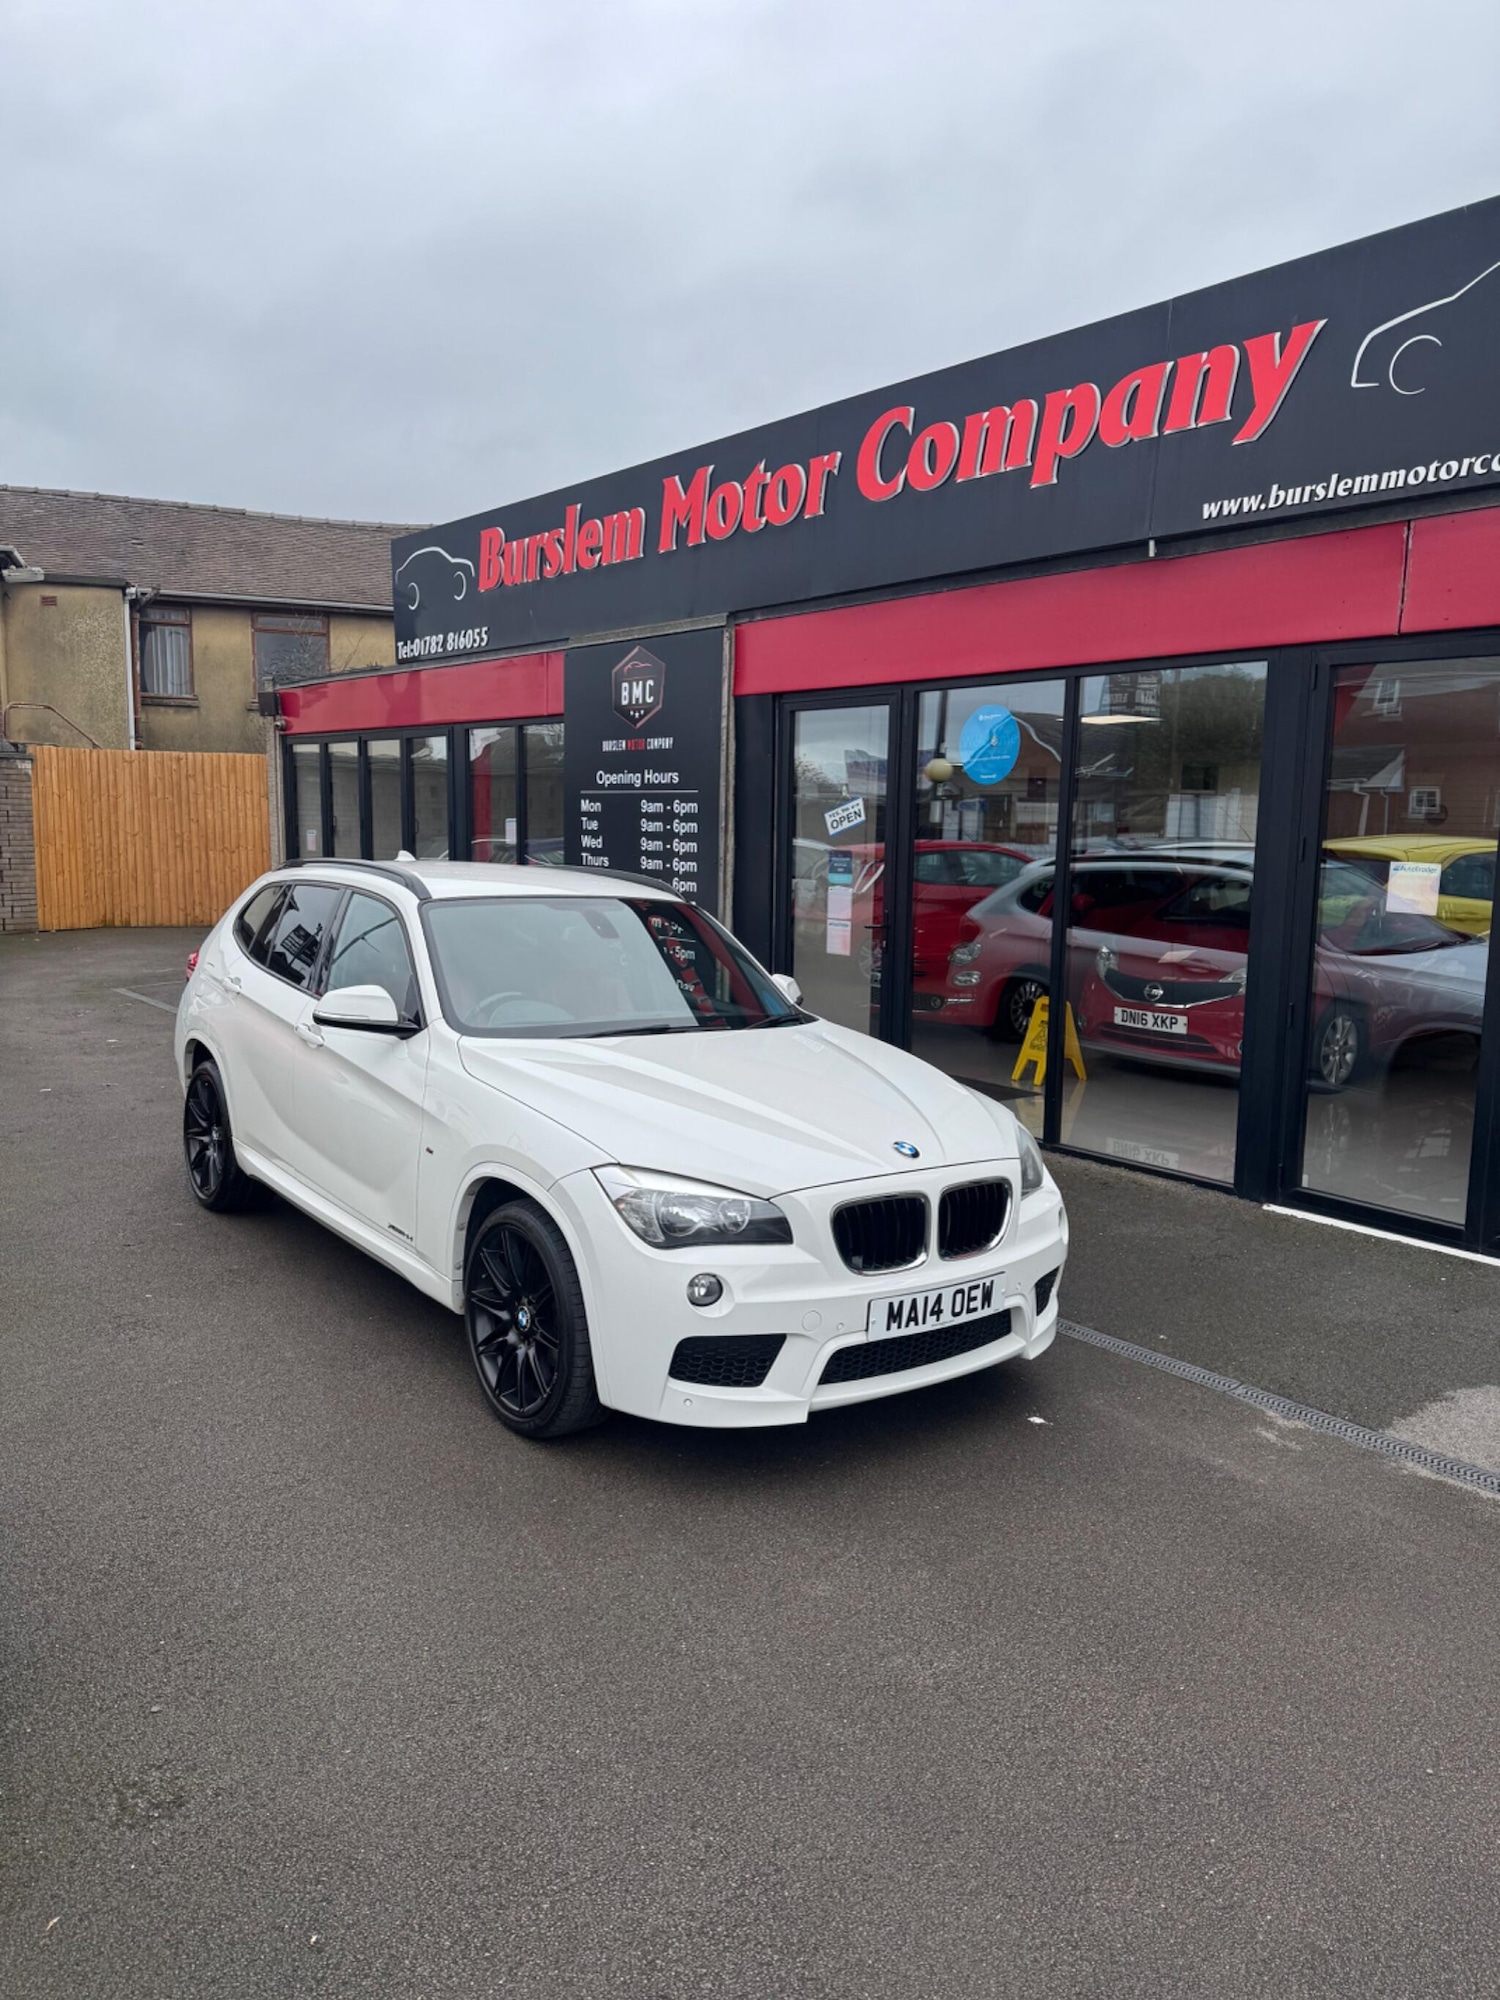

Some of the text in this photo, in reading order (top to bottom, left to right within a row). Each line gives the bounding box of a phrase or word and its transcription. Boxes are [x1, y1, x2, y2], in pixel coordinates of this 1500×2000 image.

[478, 318, 1329, 593] Burslem Motor Company
[397, 626, 489, 660] Tel:01782 816055
[621, 679, 655, 706] BMC
[596, 769, 679, 787] Opening Hours
[580, 799, 602, 812] Mon
[640, 799, 664, 812] 9am
[672, 800, 698, 816] 6pm
[580, 817, 599, 830] Tue
[640, 818, 664, 832] 9am
[672, 819, 698, 836] 6pm
[830, 808, 862, 829] OPEN
[580, 835, 603, 849] Wed
[640, 837, 664, 851] 9am
[672, 838, 698, 855] 6pm
[580, 852, 609, 867] Thurs
[640, 856, 664, 870] 9am
[672, 857, 698, 875] 6pm
[672, 877, 697, 893] 6pm
[674, 945, 696, 961] 5pm
[1121, 1009, 1178, 1031] DN16 XKP
[886, 1280, 994, 1331] MA14 OEW
